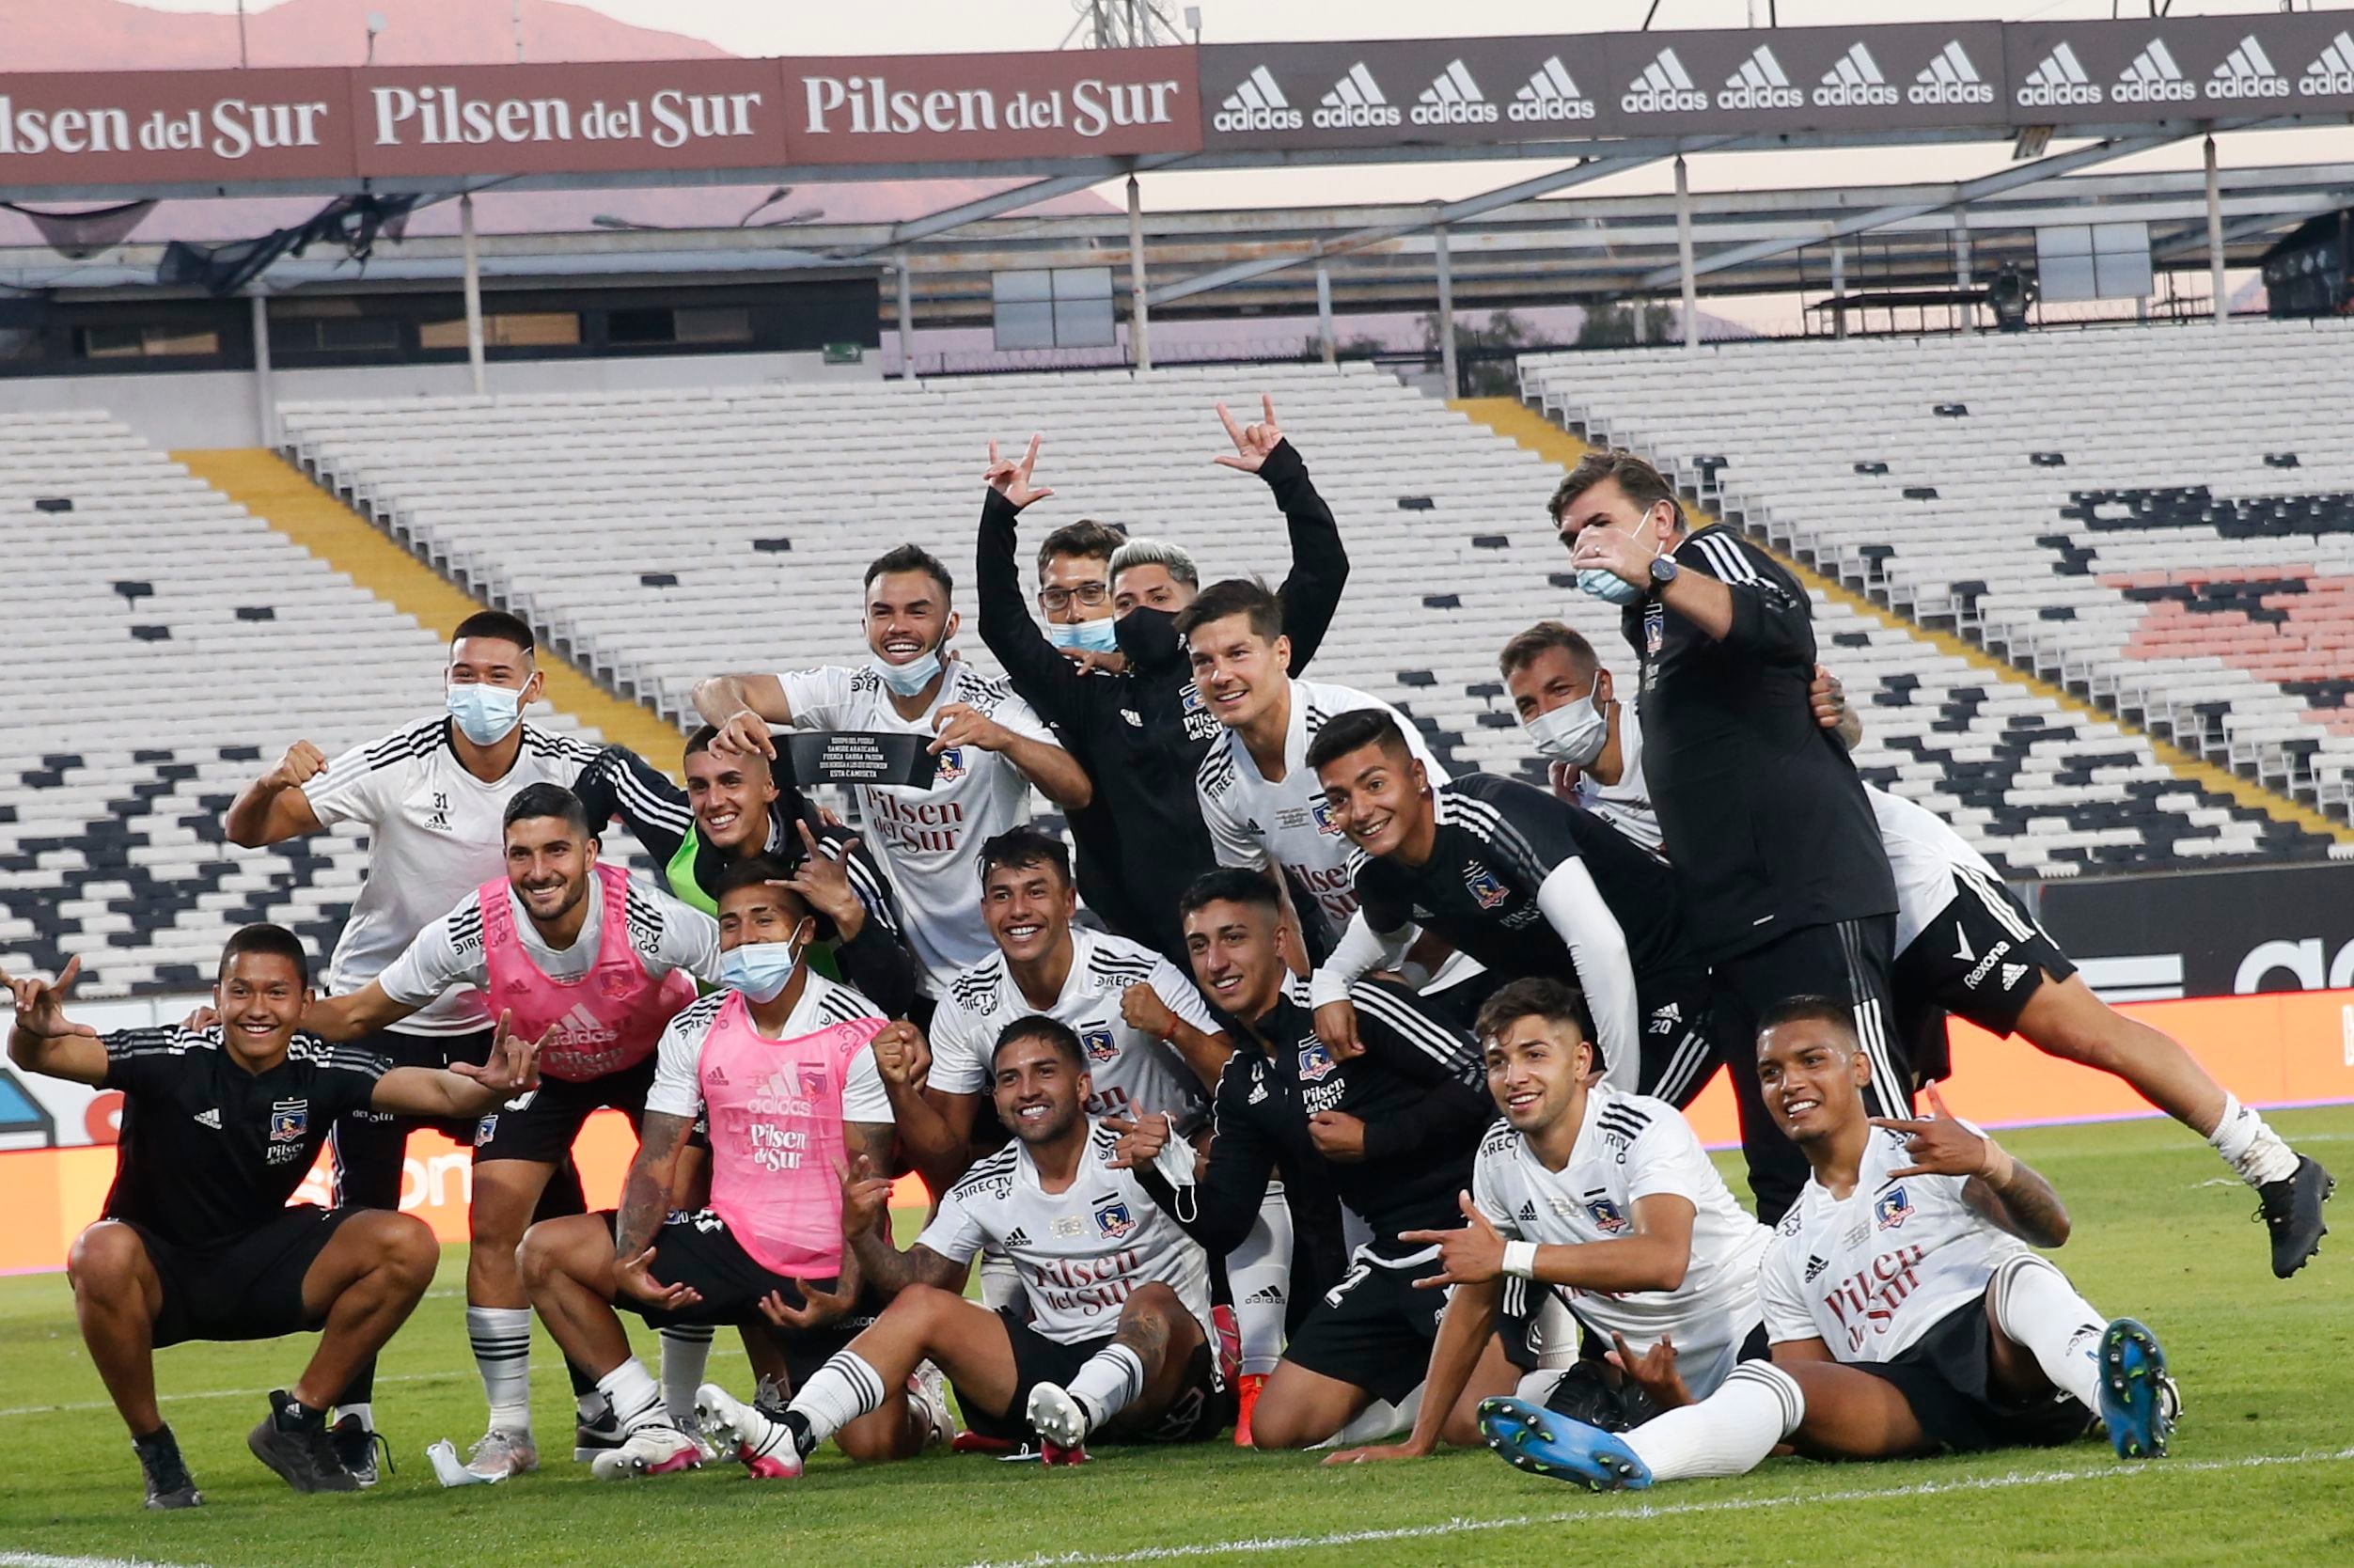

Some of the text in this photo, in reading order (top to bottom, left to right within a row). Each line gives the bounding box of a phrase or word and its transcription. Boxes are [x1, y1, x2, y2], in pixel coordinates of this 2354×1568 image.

[1717, 86, 1804, 110] adidas
[1813, 82, 1899, 106] adidas
[1907, 80, 1994, 105] adidas
[2017, 82, 2102, 106] adidas
[2111, 79, 2197, 103] adidas
[2205, 75, 2290, 100] adidas
[802, 75, 1179, 136] Pilsen del Sur
[1410, 101, 1499, 125] adidas
[1507, 97, 1596, 121] adidas
[1621, 89, 1708, 113] adidas
[138, 111, 205, 151] del
[211, 98, 328, 159] Sur
[370, 85, 762, 149] Pilsen del Sur
[1213, 107, 1303, 132] adidas
[1311, 104, 1402, 129] adidas
[1189, 720, 1223, 741] del Su
[433, 792, 448, 809] 31
[902, 825, 961, 854] Sur
[639, 943, 660, 954] GO
[1963, 941, 2011, 990] Rexona
[981, 1001, 997, 1016] GO
[1648, 1019, 1672, 1034] 20
[1302, 1077, 1346, 1105] Pilsen
[1319, 1089, 1345, 1110] Sur
[746, 1096, 812, 1116] adidas
[750, 1124, 807, 1150] Pilsen
[766, 1148, 803, 1172] Sur
[953, 1177, 1012, 1201] DIRECTV
[1004, 1238, 1032, 1247] adidas
[1046, 1277, 1137, 1317] del Sur
[1245, 1296, 1285, 1305] adidas
